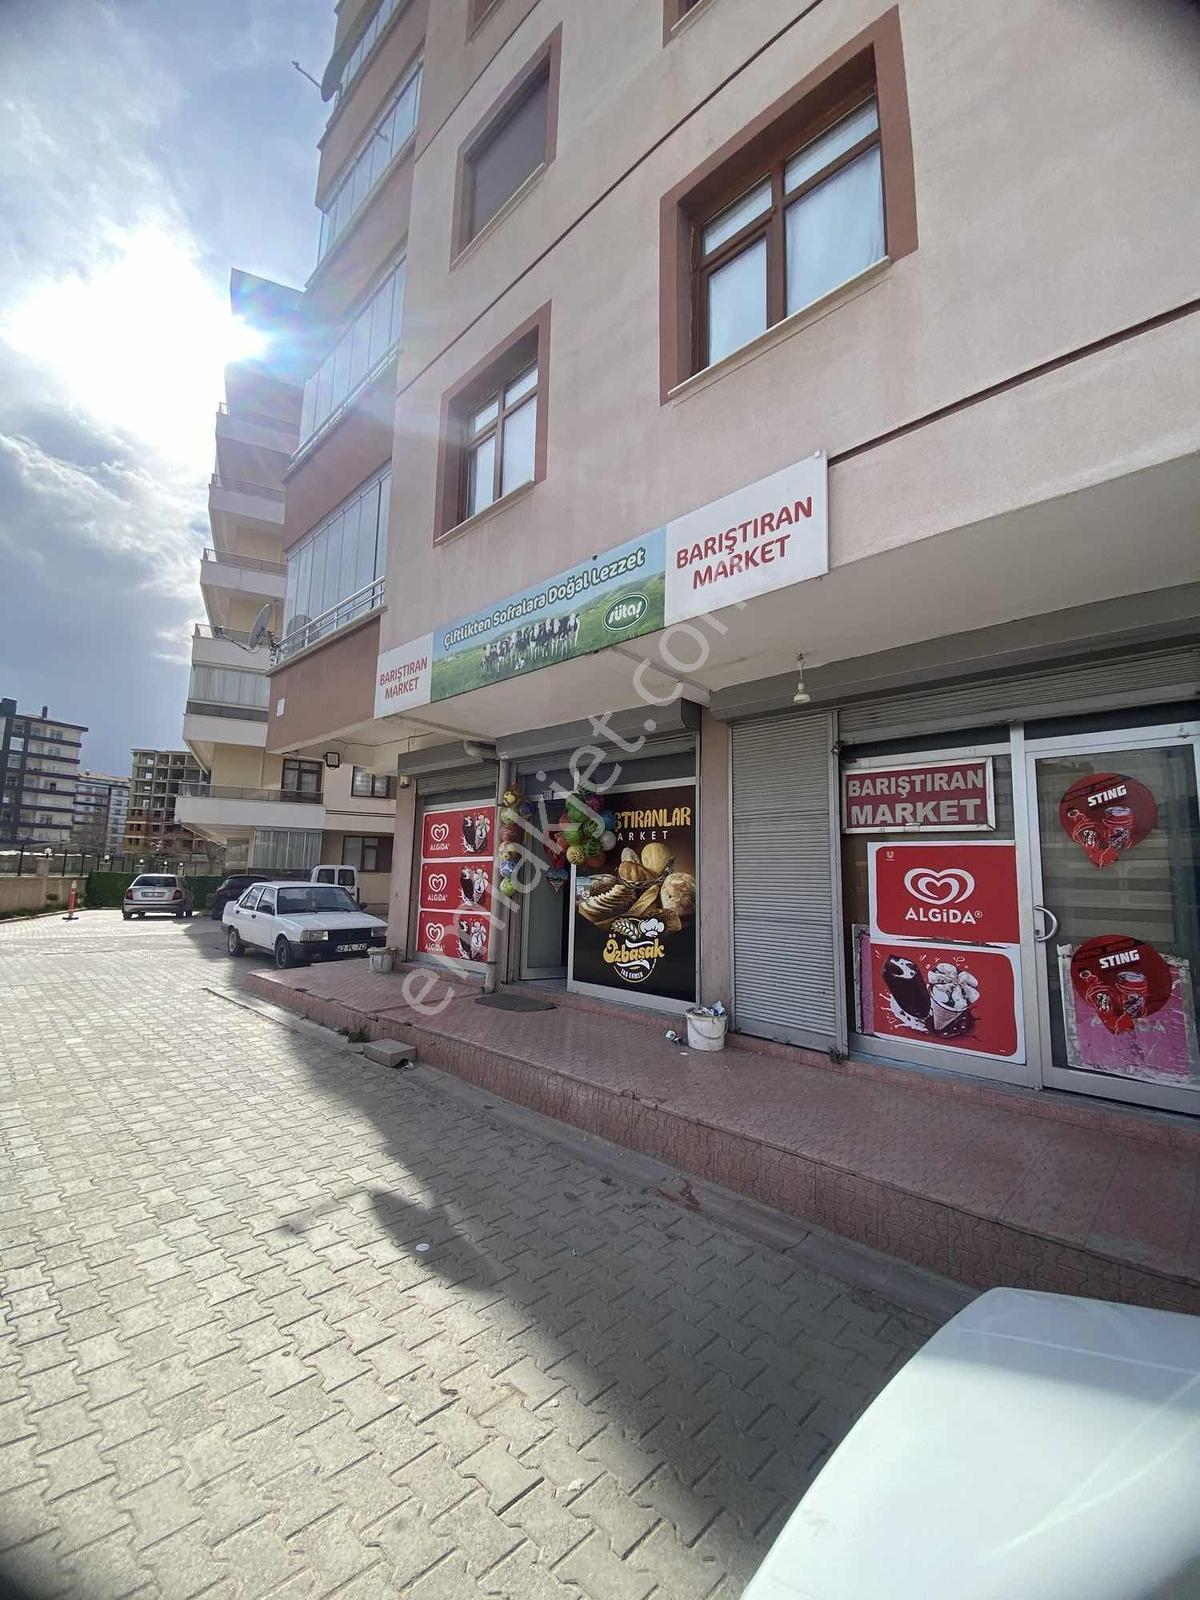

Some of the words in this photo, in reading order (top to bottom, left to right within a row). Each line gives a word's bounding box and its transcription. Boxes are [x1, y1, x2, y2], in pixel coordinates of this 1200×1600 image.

[676, 496, 813, 569] BARIŞTIRAN
[693, 534, 791, 589] MARKET
[444, 617, 491, 650] Çiftlikten
[493, 594, 546, 626] Sofralara
[548, 572, 590, 603] Doğal
[592, 548, 645, 585] Lezzet
[379, 657, 428, 685] BARIŞTIRAN
[385, 676, 420, 700] MARKET
[848, 769, 984, 797] BARIŞTIRAN
[1087, 785, 1127, 807] STING
[851, 799, 982, 825] MARKET
[617, 831, 669, 842] ARKET
[1098, 949, 1140, 969] STING
